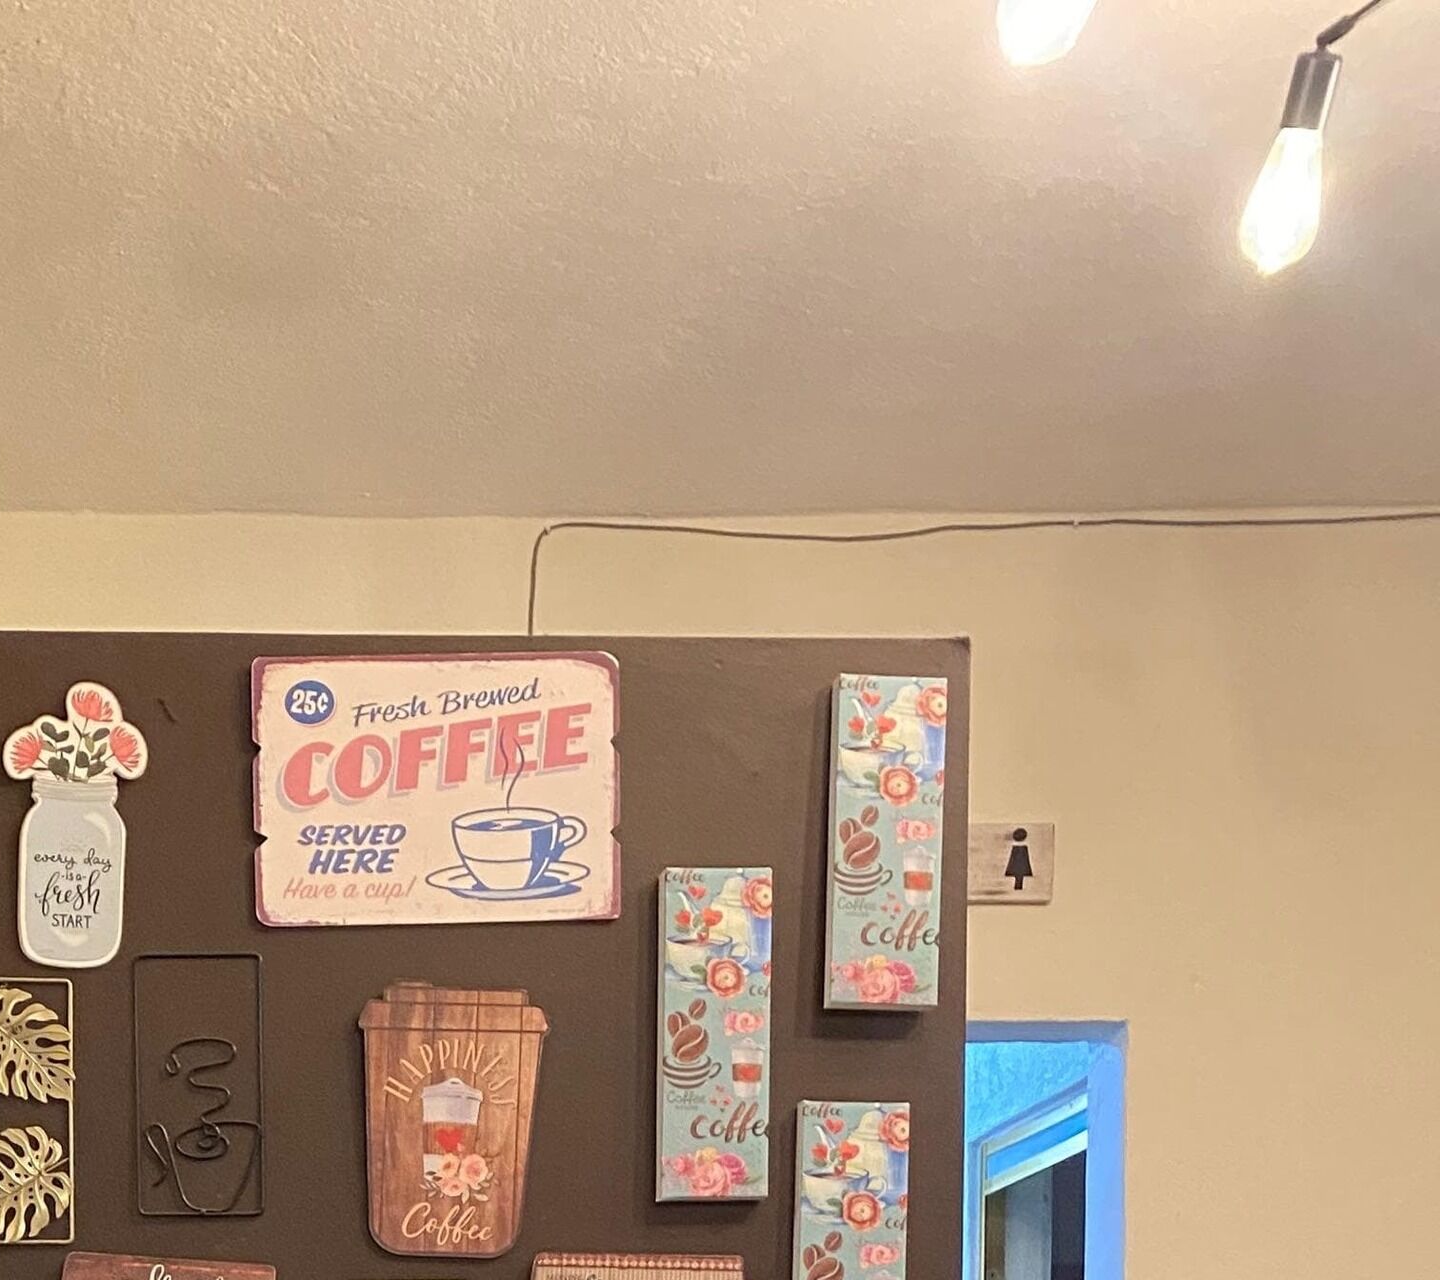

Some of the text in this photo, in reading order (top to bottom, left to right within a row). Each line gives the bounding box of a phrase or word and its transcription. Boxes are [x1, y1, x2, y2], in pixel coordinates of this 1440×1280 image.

[290, 688, 329, 715] 25¢
[352, 678, 542, 727] Fresh Brewed
[280, 702, 593, 808] COFFEE
[297, 824, 407, 848] SERVED
[34, 847, 112, 873] every day
[308, 848, 400, 875] HERE
[34, 869, 101, 917] fresh
[282, 875, 418, 905] Have a cup!
[51, 913, 92, 929] START
[383, 1039, 517, 1105] HAPPINESS
[401, 1201, 493, 1246] Coffee
